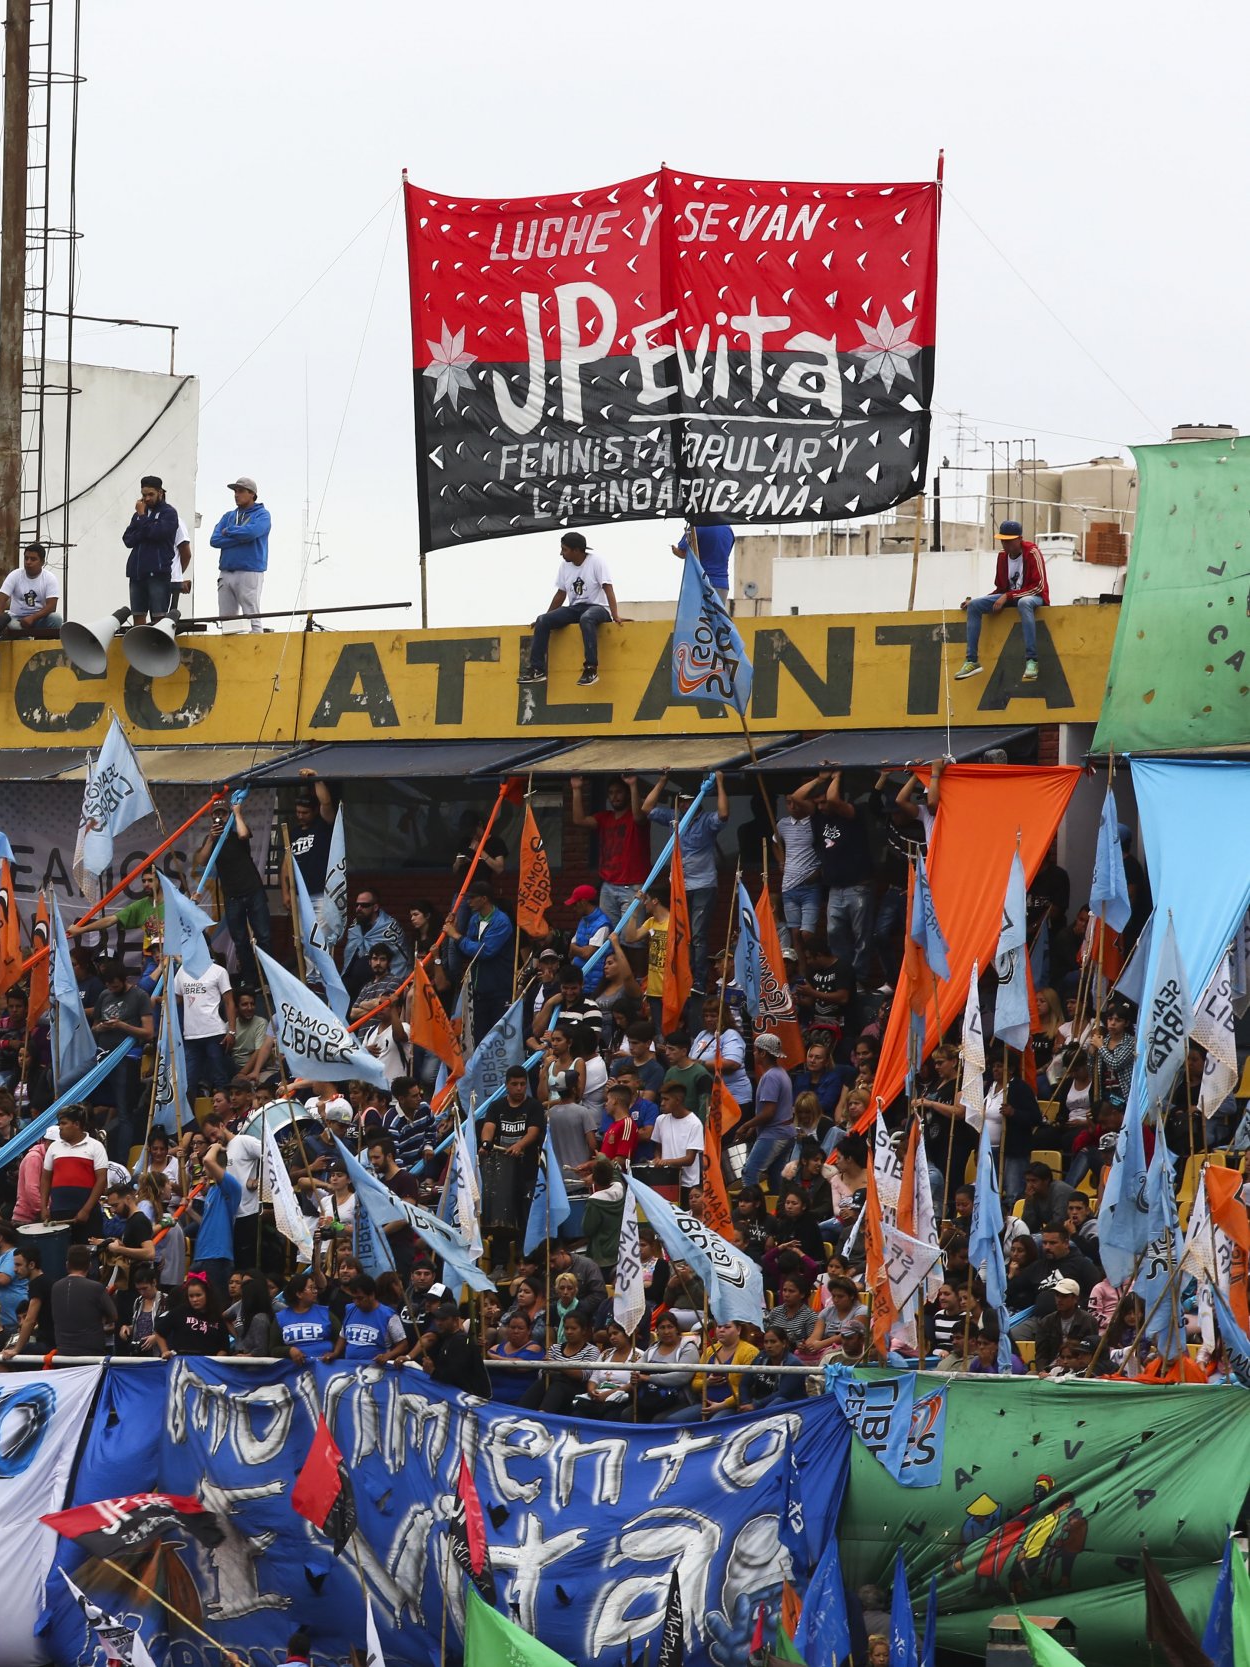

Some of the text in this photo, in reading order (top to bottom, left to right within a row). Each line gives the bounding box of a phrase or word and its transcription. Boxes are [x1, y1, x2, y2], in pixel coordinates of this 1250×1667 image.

[490, 202, 826, 261] LUCHE Y SE VAN
[493, 281, 617, 435] JP
[837, 437, 859, 474] Y
[12, 846, 188, 898] EAOS
[527, 869, 551, 915] LIBRE
[281, 1002, 339, 1043] SEAMOS
[282, 1021, 354, 1066] LIBRES
[501, 1122, 526, 1132] BERLIN
[282, 1326, 323, 1342] CTEP
[345, 1327, 378, 1343] CTEP
